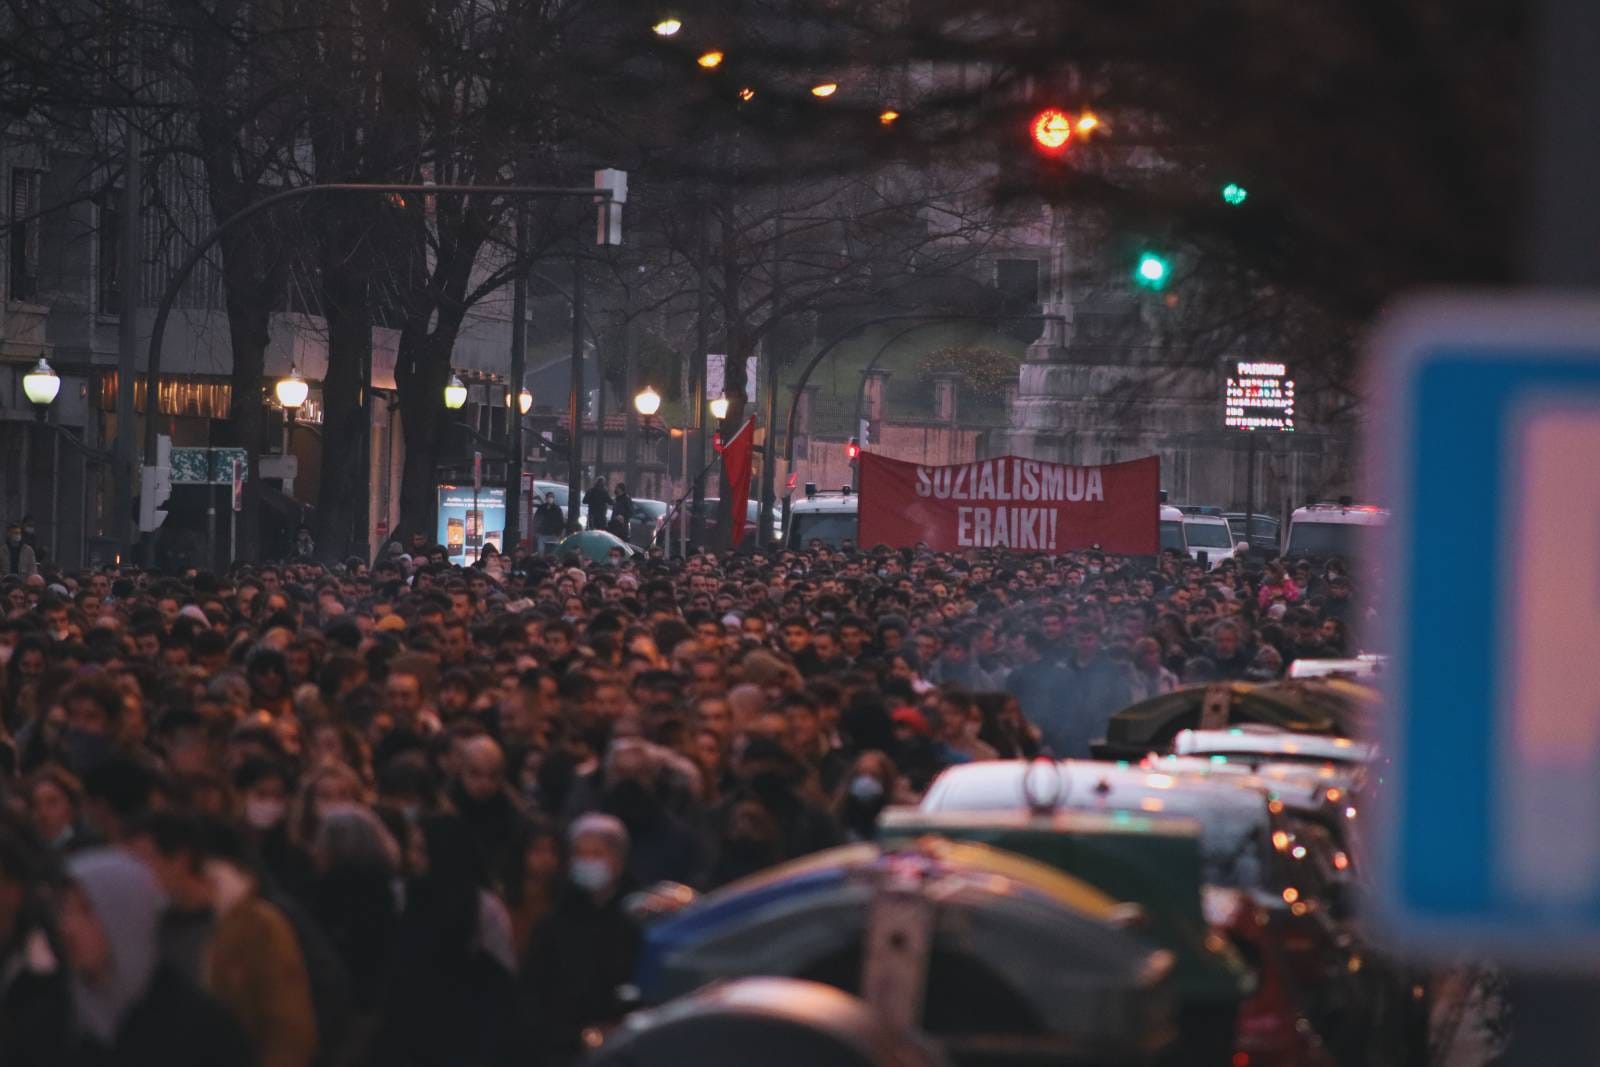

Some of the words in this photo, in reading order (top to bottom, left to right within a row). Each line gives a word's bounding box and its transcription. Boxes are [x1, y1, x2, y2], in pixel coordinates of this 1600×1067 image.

[1238, 363, 1285, 375] PARKING
[1227, 388, 1243, 397] PIO
[957, 506, 1058, 550] ERAIKI!
